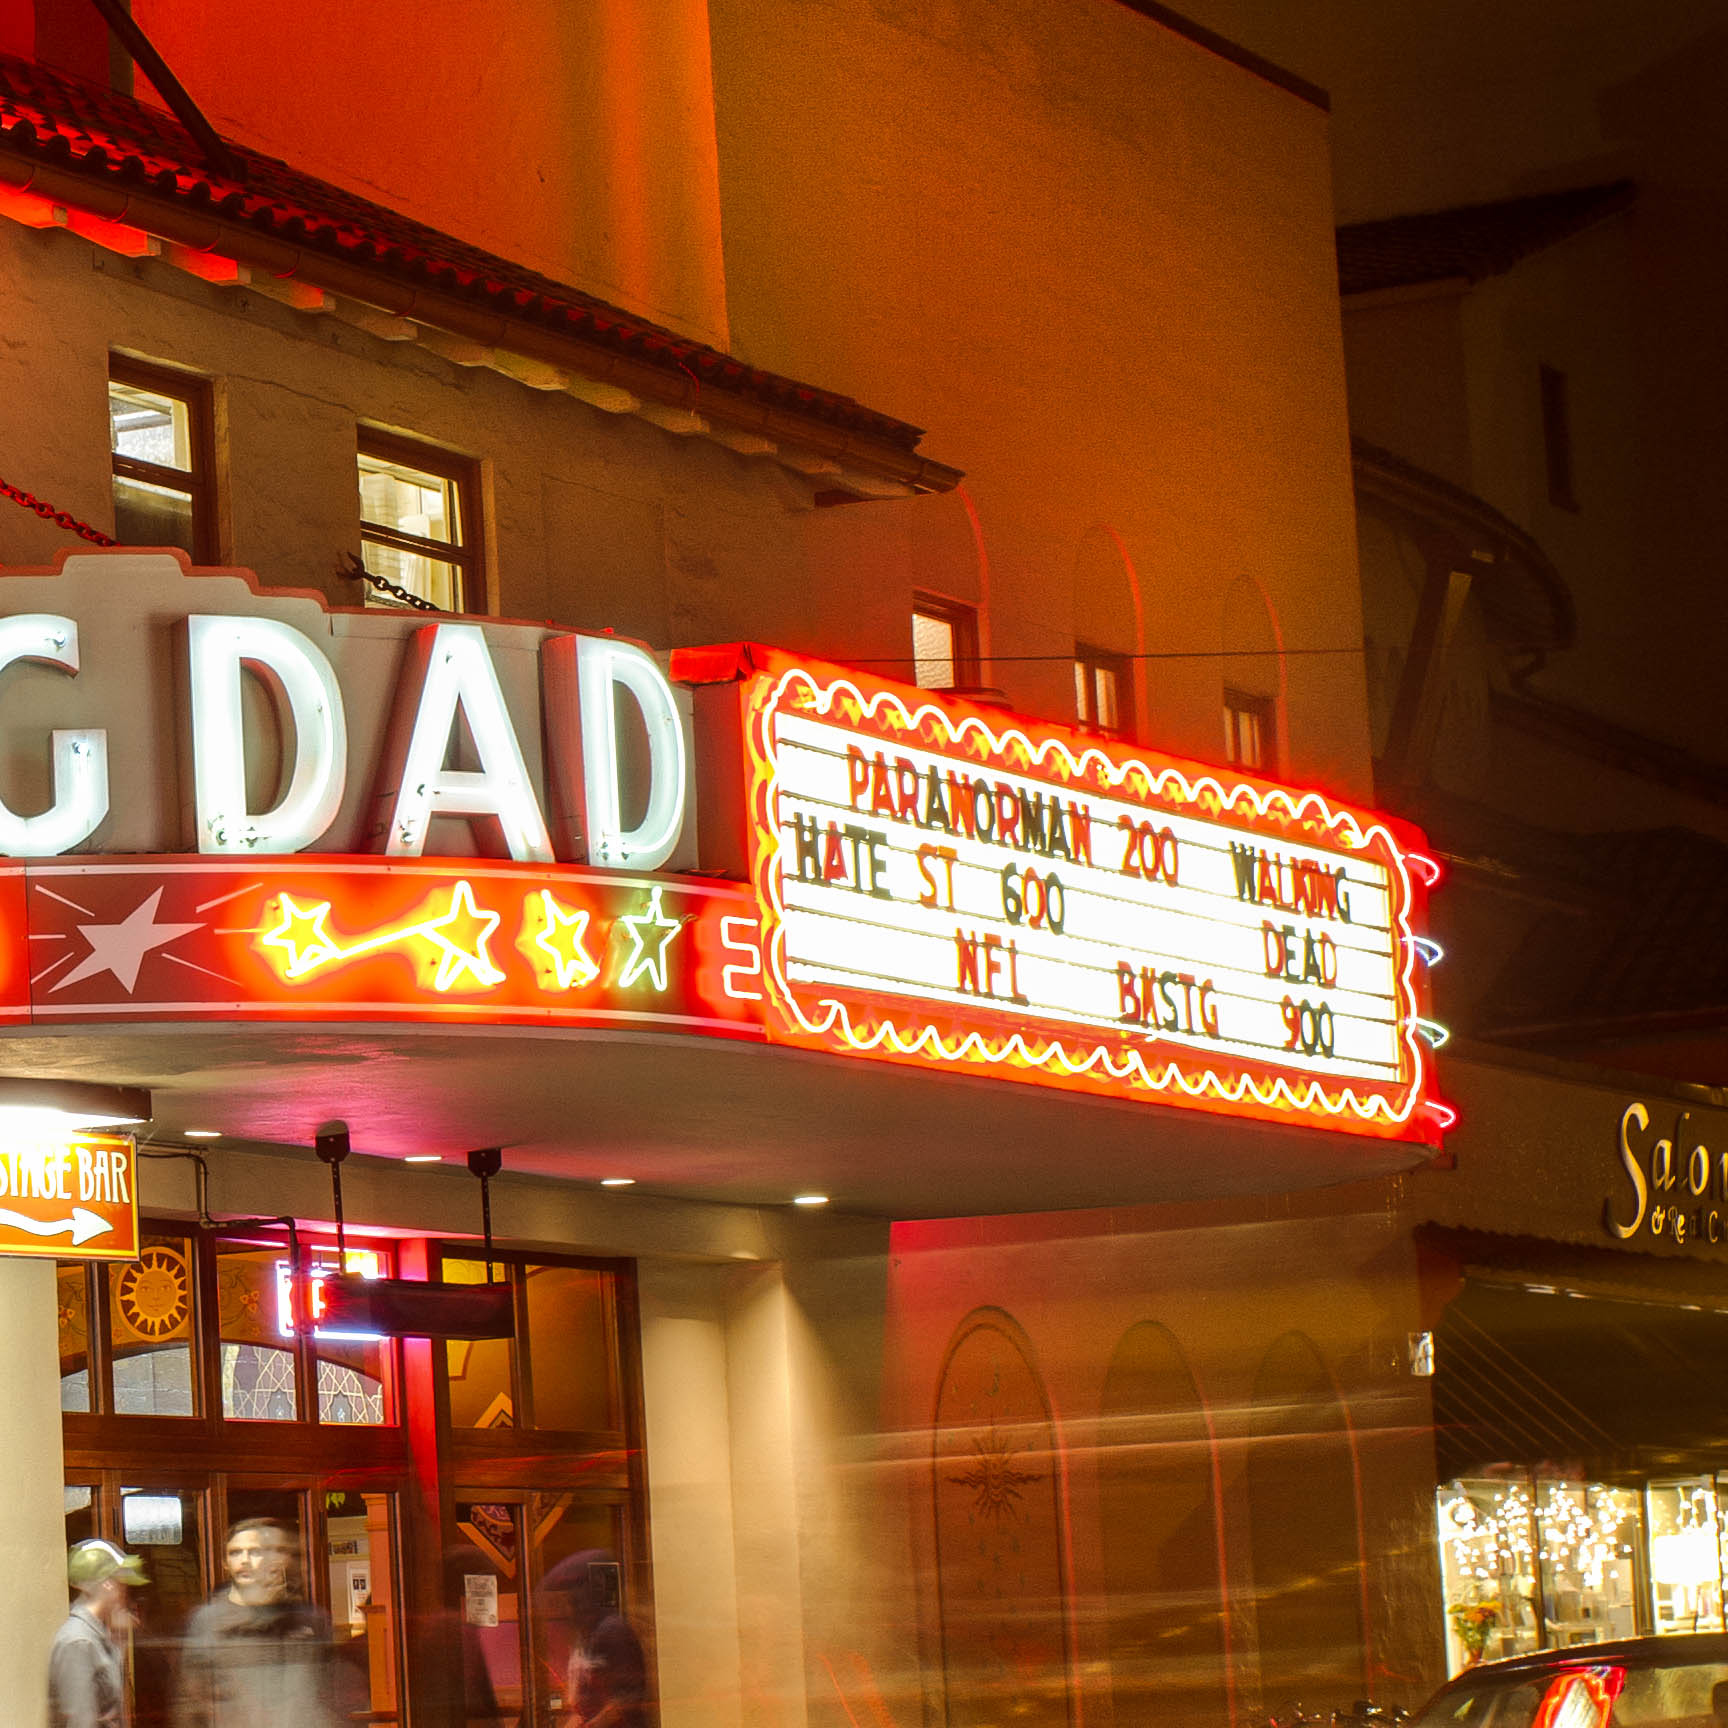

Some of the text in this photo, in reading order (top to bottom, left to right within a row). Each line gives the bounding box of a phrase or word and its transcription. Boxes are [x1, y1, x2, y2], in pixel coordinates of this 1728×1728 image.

[793, 812, 1337, 990] HATE ST 600 DEAD
[848, 743, 1350, 924] PARANORMAN 200 WALKING
[956, 927, 1334, 1058] NFL BKSTG 900
[75, 1146, 130, 1203] BAR
